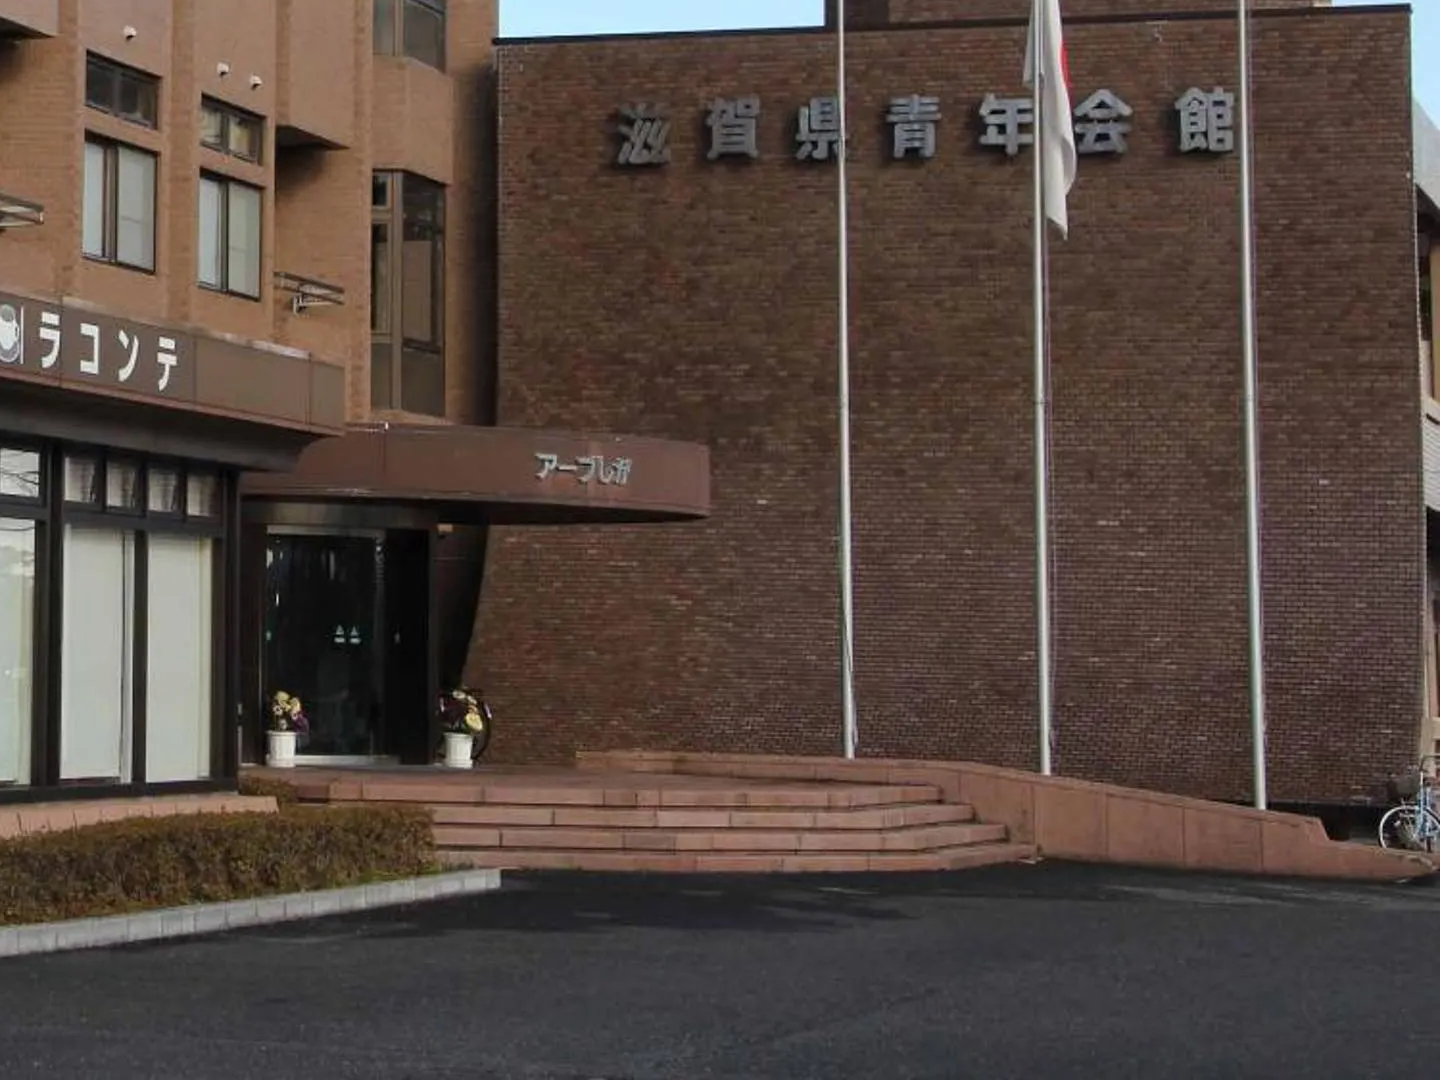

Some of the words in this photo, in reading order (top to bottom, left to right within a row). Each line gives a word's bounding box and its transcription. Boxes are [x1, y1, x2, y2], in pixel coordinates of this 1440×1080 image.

[617, 86, 1235, 165] 滋賀県青年会館
[38, 311, 178, 392] ラコンテ
